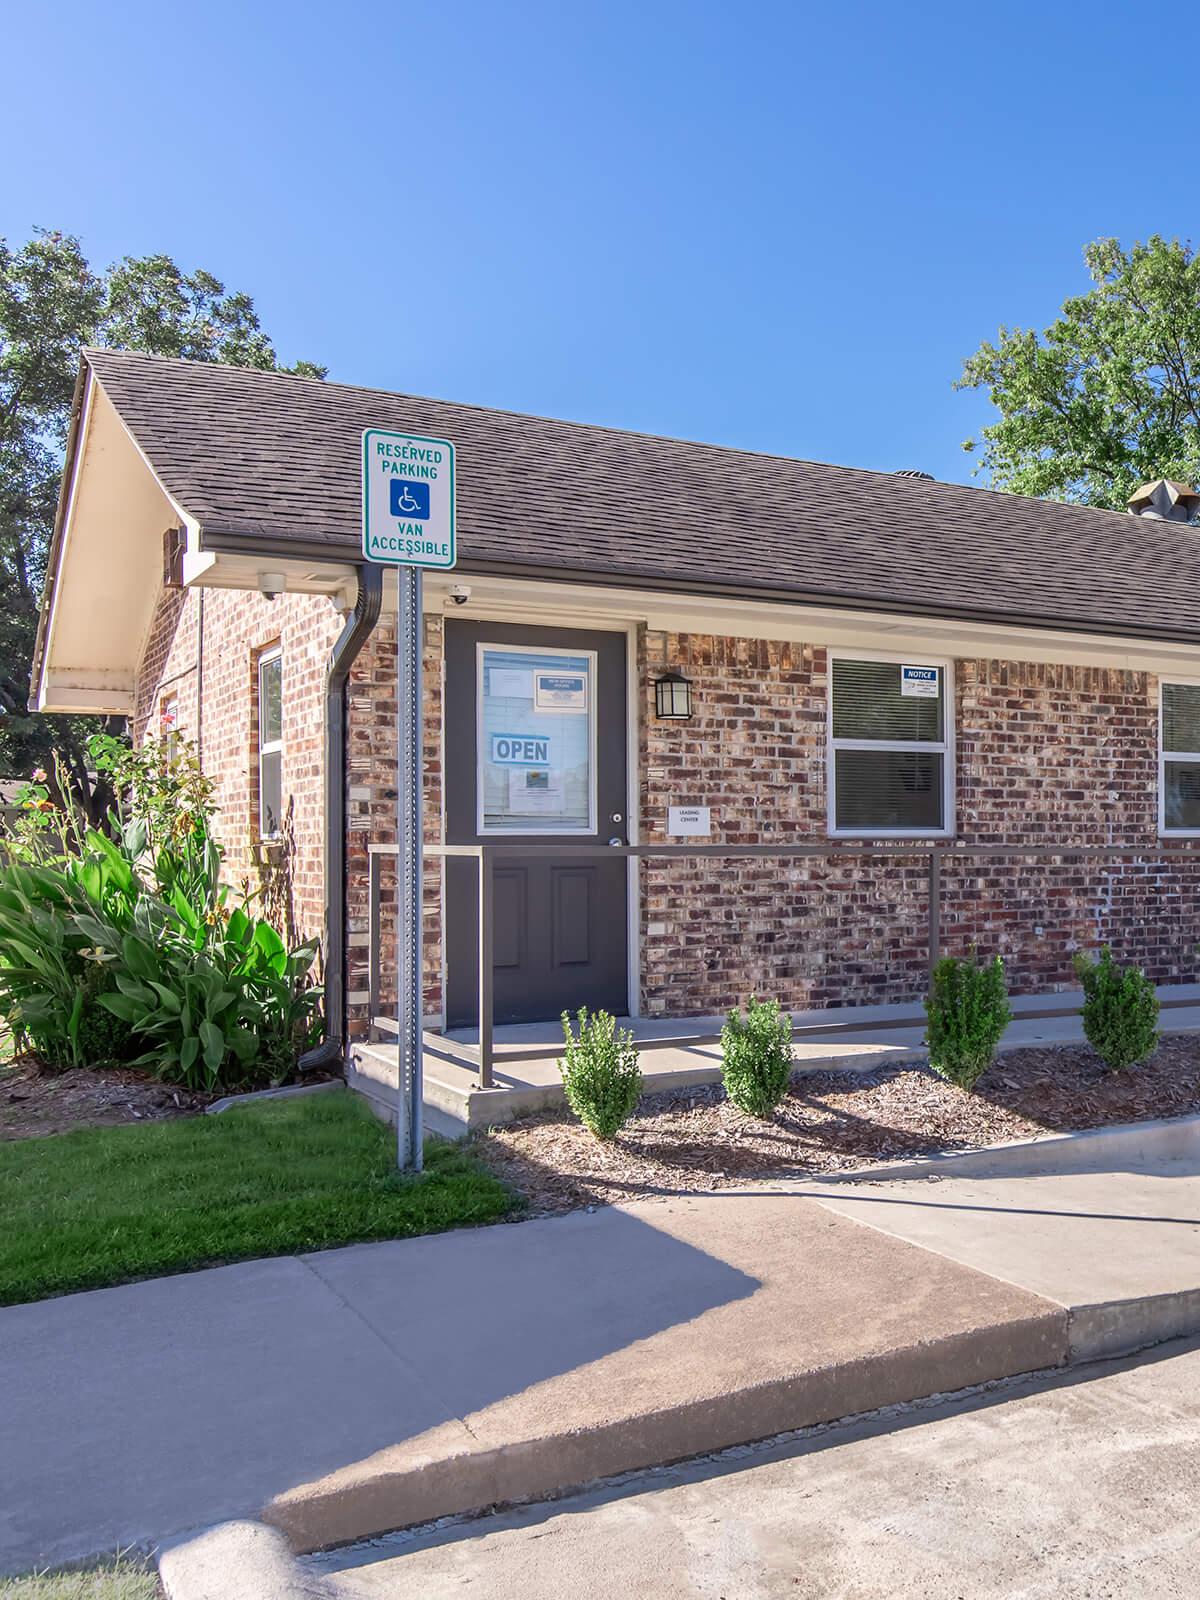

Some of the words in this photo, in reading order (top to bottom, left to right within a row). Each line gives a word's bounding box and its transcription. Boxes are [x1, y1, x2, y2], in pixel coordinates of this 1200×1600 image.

[377, 442, 442, 463] RESERVED
[382, 461, 438, 480] PARKING
[398, 522, 423, 537] VAN
[372, 536, 448, 556] ACCESSIBLE
[908, 671, 932, 679] NOTICE
[497, 740, 547, 761] OPEN
